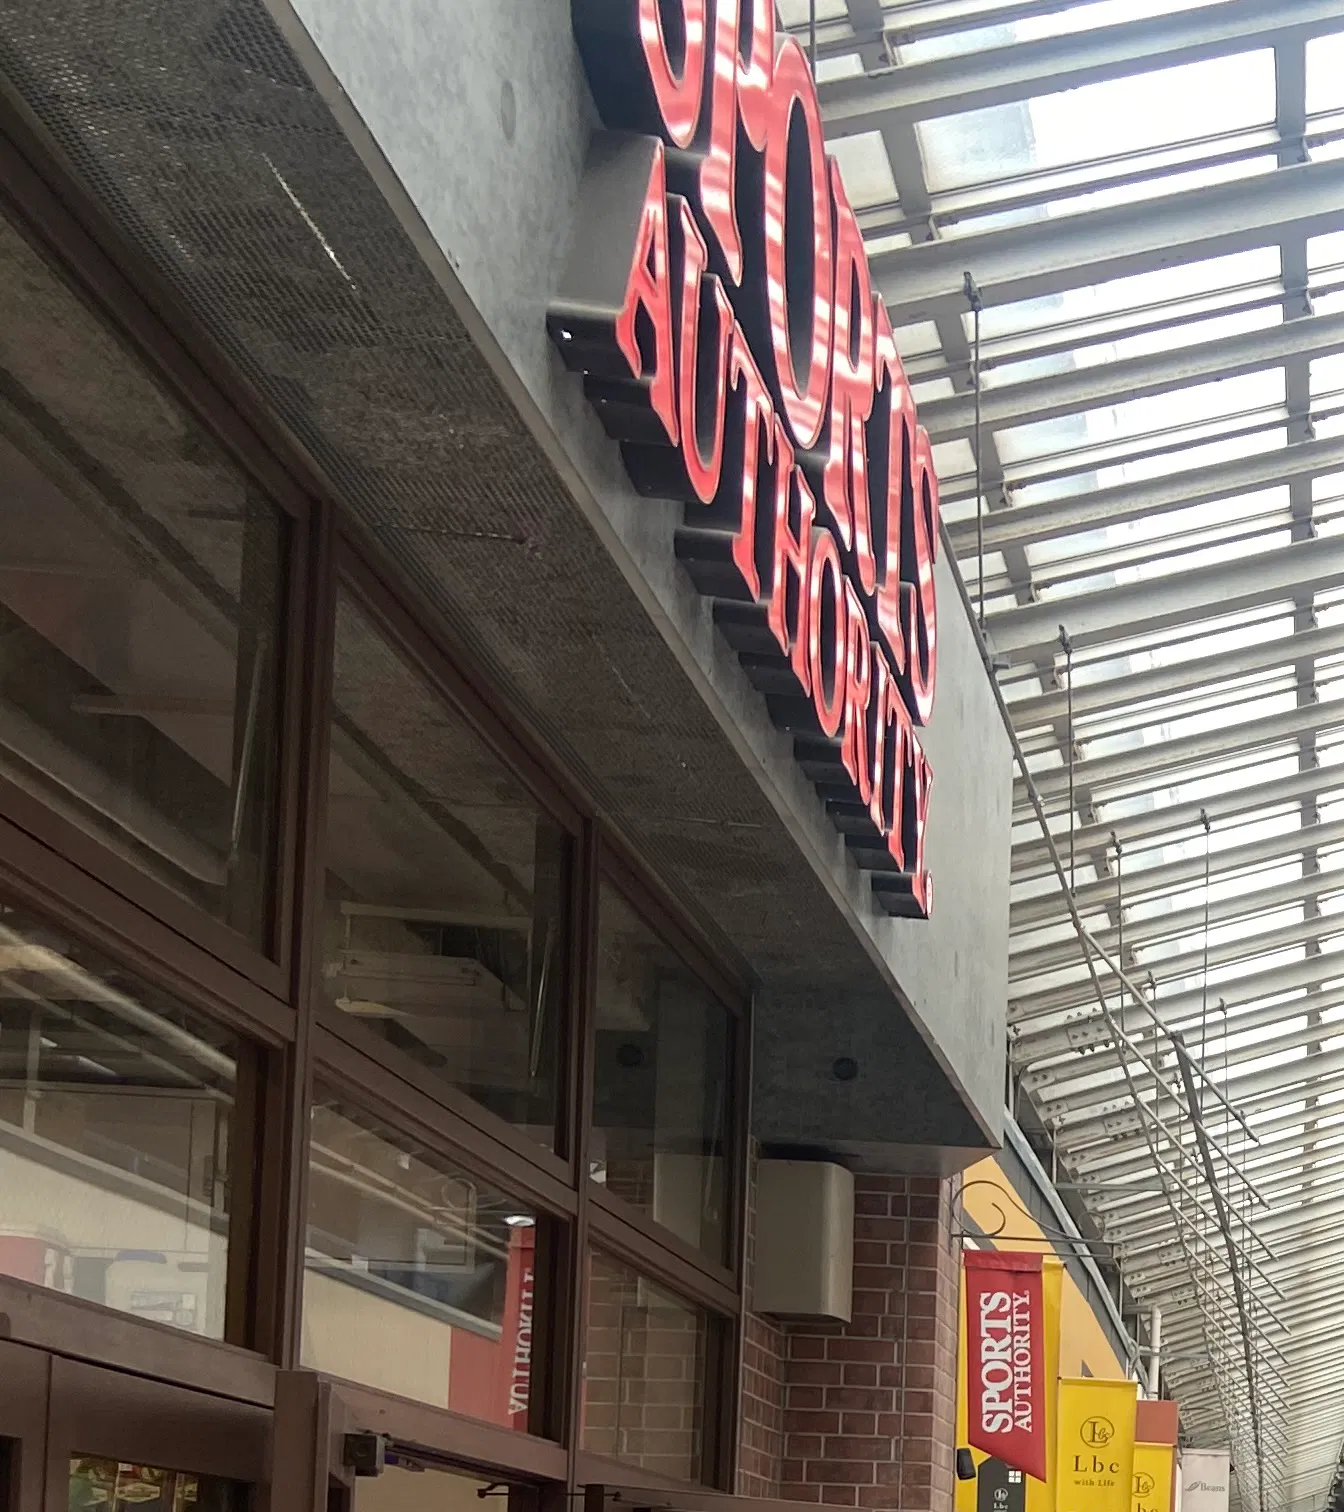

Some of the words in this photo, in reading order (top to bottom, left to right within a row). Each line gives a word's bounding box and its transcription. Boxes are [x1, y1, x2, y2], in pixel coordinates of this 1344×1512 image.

[617, 137, 934, 919] AUTHORITY
[980, 1292, 1013, 1433] SPORTS
[1013, 1292, 1032, 1433] AUTHORITY
[1074, 1455, 1120, 1474] Lbc
[1200, 1482, 1226, 1492] Beans
